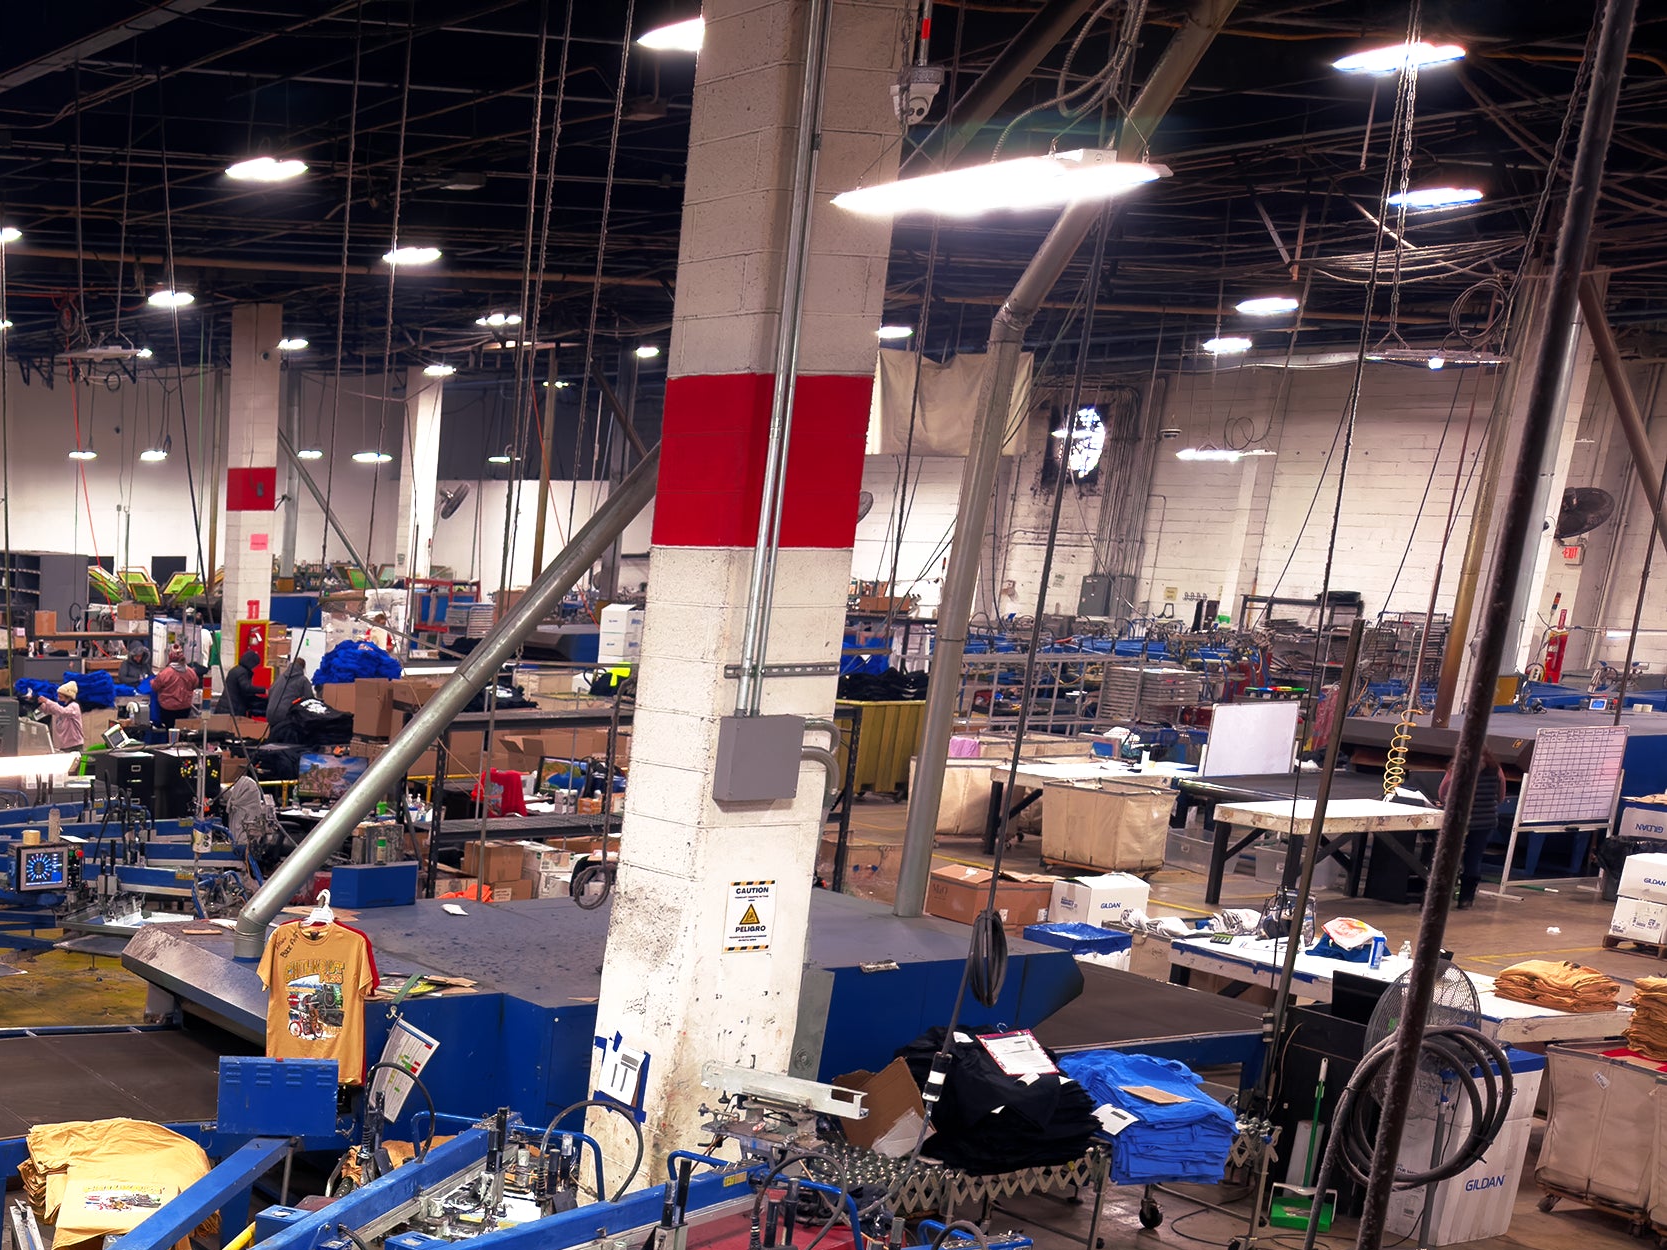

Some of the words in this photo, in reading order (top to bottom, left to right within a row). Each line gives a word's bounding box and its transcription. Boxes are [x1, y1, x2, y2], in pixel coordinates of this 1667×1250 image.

[1643, 877, 1667, 887] GILDAN
[735, 886, 769, 895] CAUTION
[734, 925, 767, 933] PELIGRO
[1465, 1175, 1507, 1192] GILDAN
